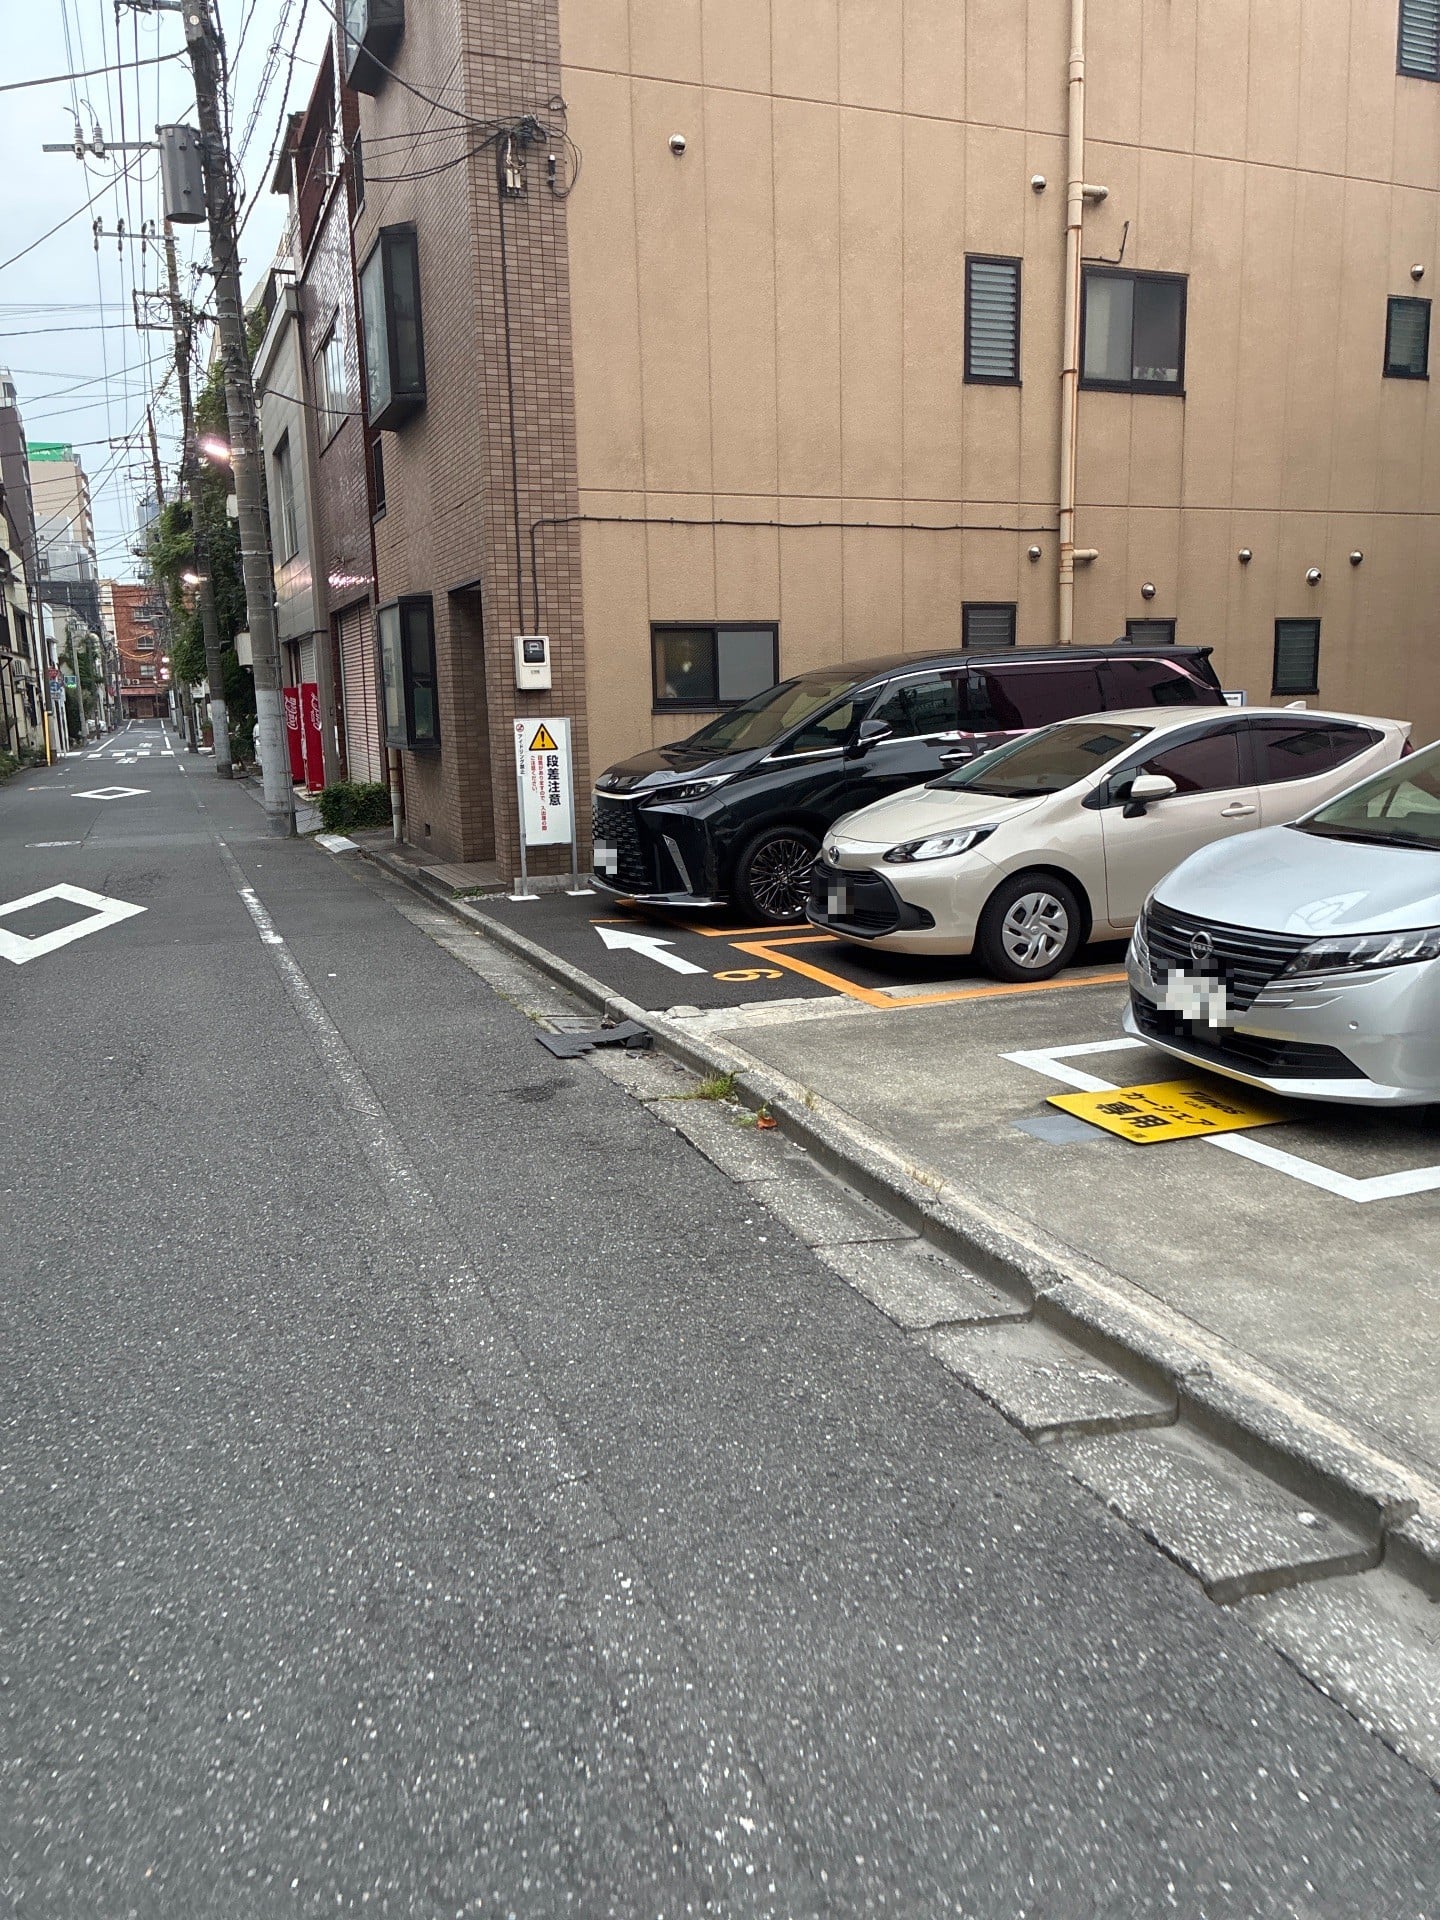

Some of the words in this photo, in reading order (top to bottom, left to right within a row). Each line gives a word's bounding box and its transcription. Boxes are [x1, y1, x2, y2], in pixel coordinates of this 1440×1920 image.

[546, 754, 562, 806] 段差注意
[1095, 1101, 1173, 1129] 専用
[1120, 1092, 1218, 1127] カーシェア
[1179, 1090, 1246, 1115] Times
